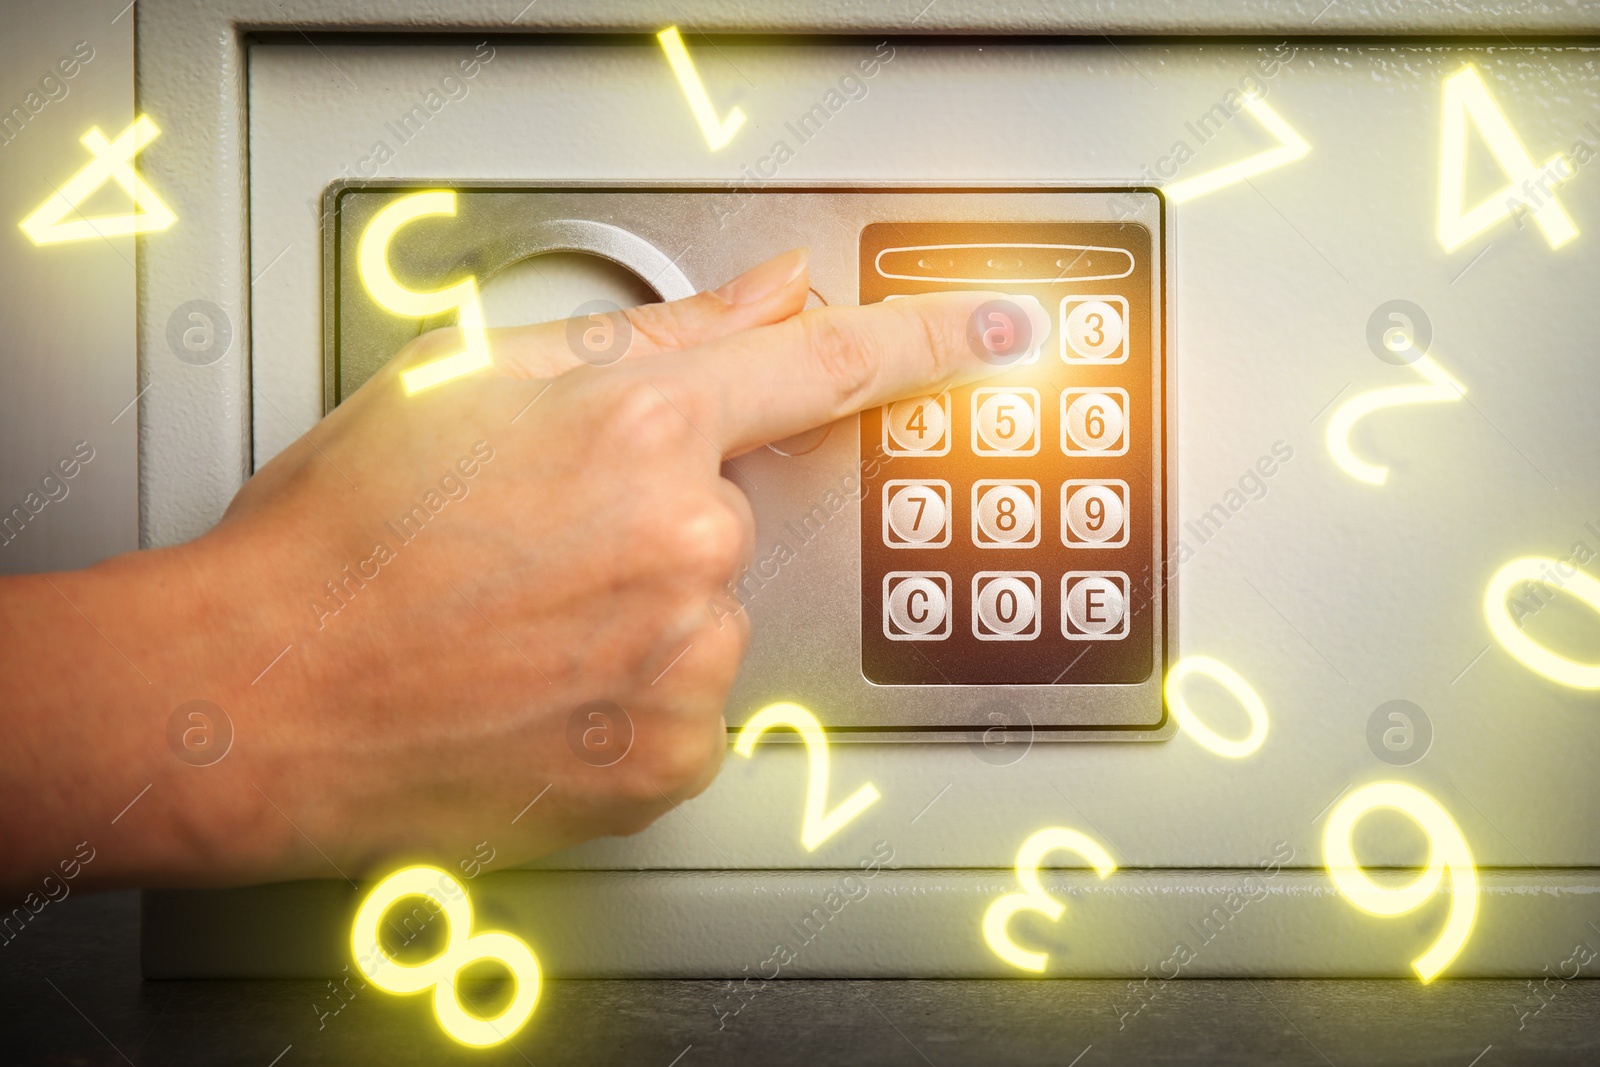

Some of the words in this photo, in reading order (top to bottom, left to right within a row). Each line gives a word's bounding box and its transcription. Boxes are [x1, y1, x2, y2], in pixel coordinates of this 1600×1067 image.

[1083, 312, 1105, 347] 3
[905, 404, 928, 439] 4
[994, 405, 1016, 439] 5
[1084, 405, 1105, 439] 6
[907, 497, 927, 531] 7
[995, 496, 1017, 531] 8
[1085, 496, 1106, 531] 9
[906, 588, 929, 623] C
[1085, 588, 1106, 622] E
